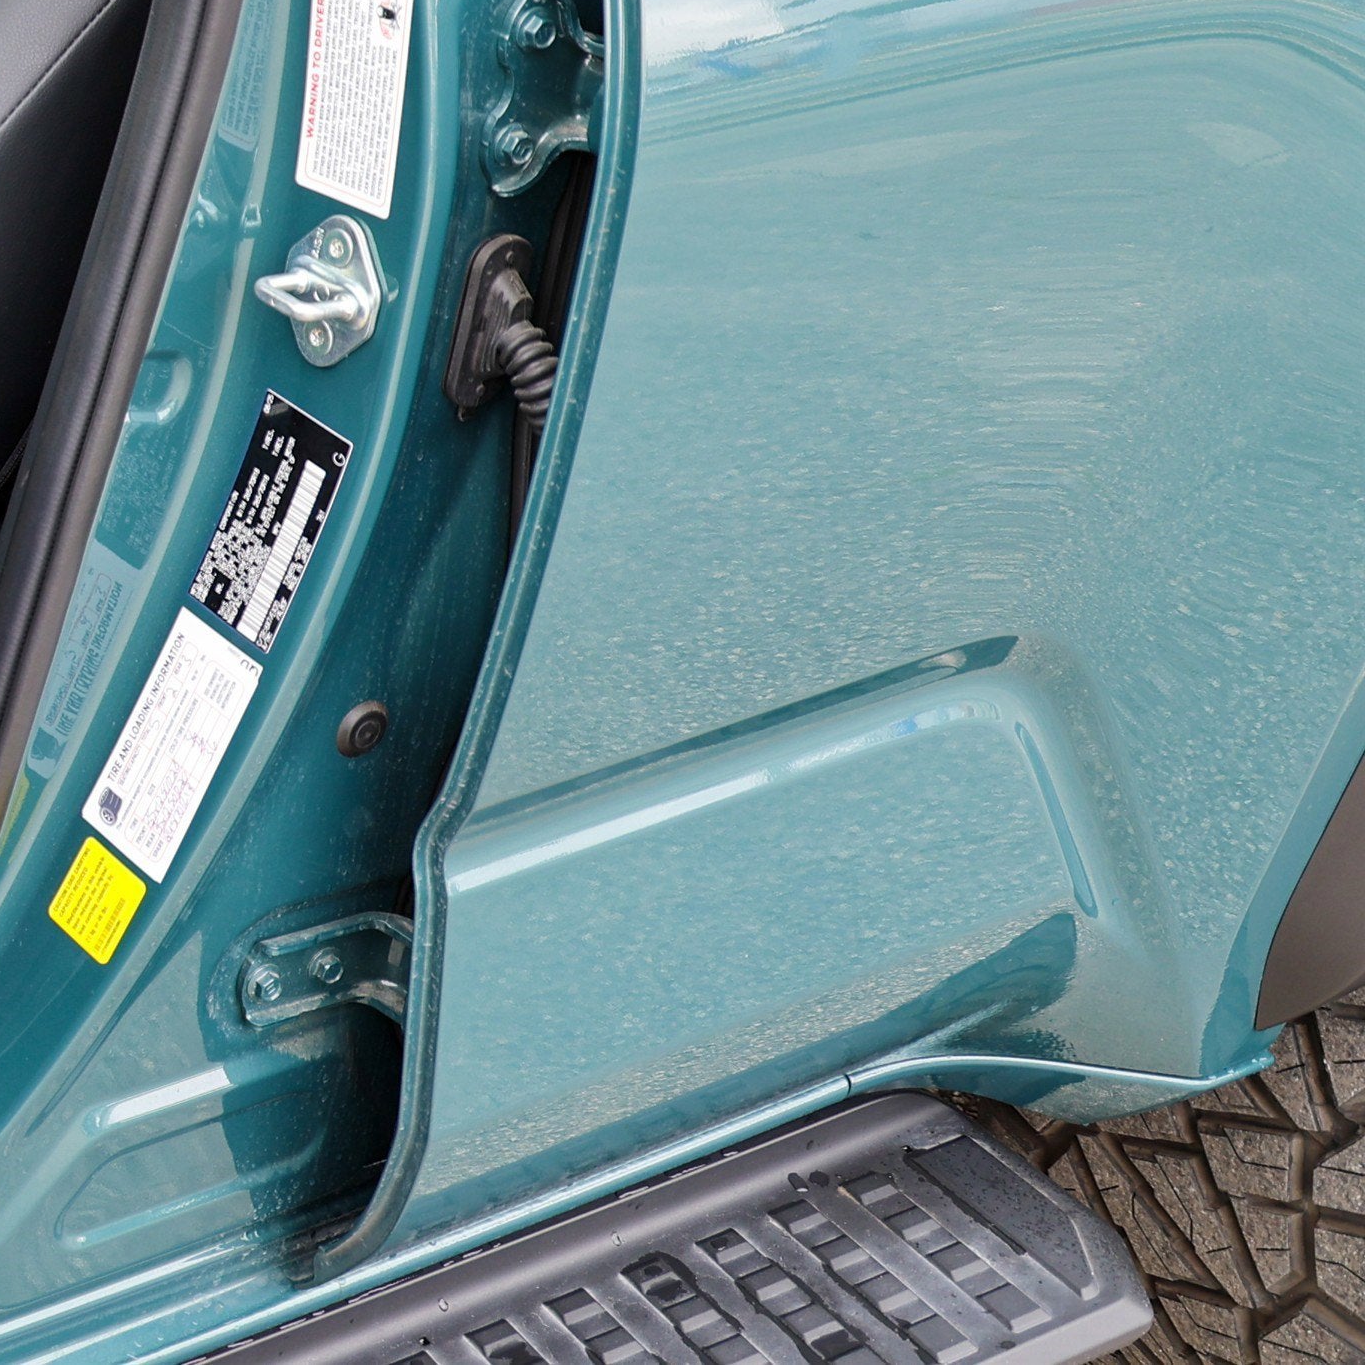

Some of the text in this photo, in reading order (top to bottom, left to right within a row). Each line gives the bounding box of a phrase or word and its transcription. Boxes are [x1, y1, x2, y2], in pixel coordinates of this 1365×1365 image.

[312, 51, 321, 67] TO
[306, 74, 319, 137] WARNING
[331, 451, 345, 468] G
[107, 633, 184, 781] TIRE AND LOADING INFORMATION
